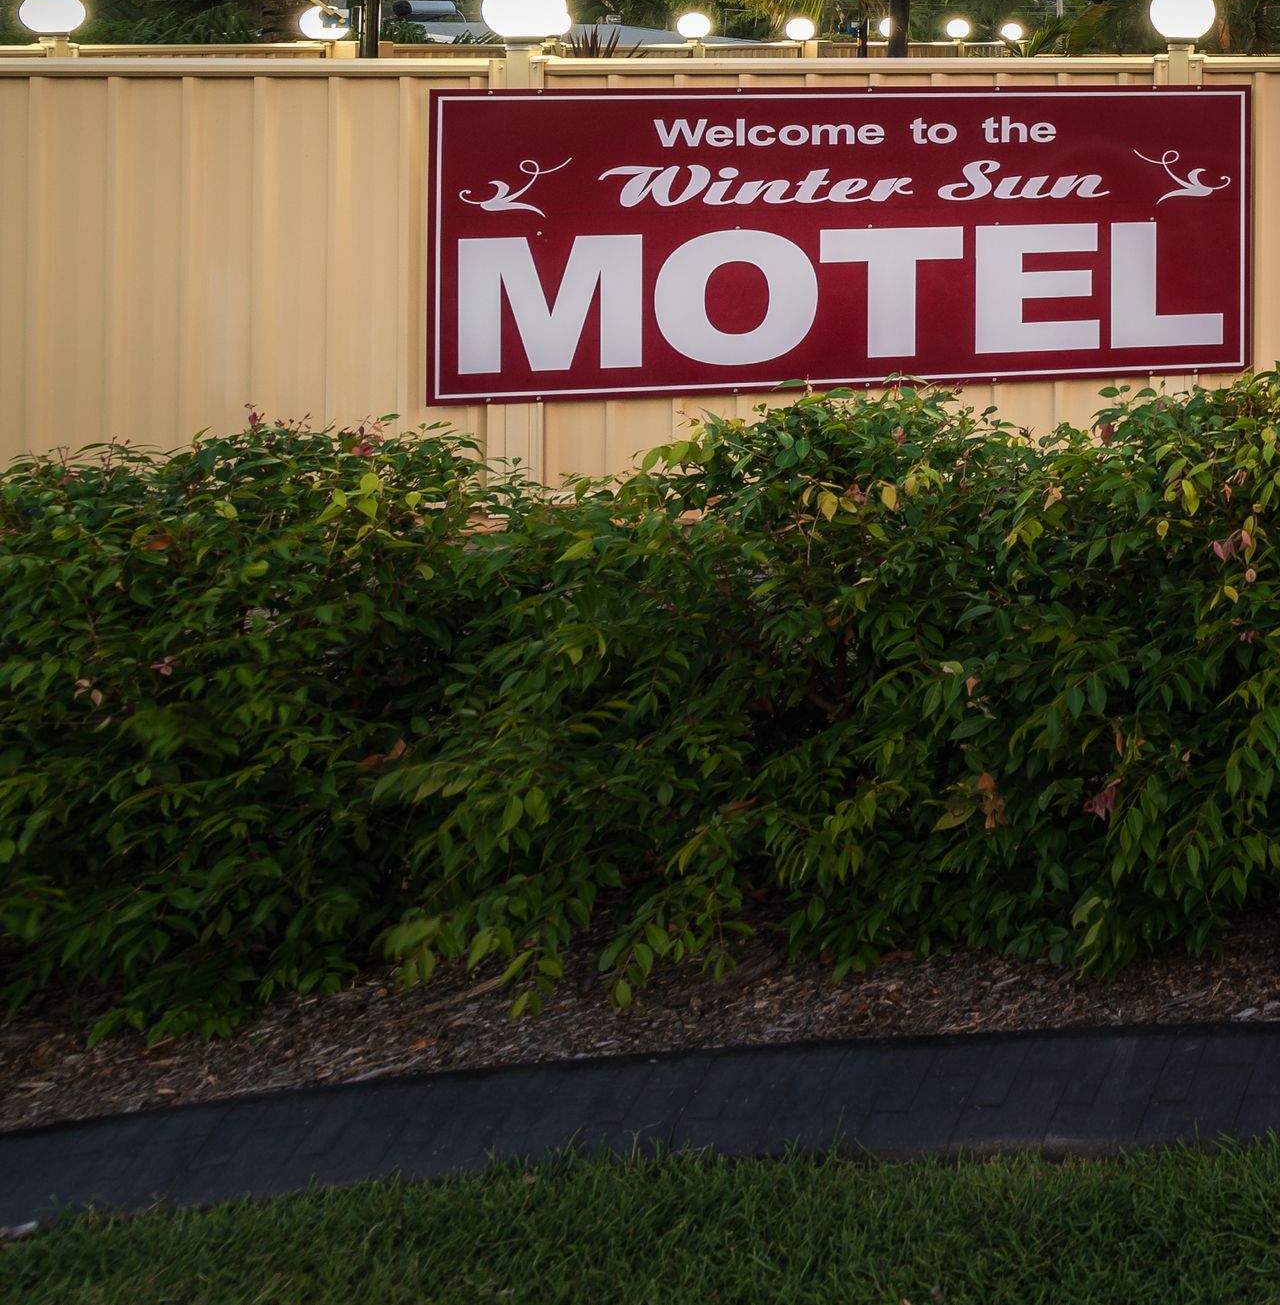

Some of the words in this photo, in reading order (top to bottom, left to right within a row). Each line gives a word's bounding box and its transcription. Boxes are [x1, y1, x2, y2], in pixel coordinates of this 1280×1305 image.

[653, 118, 886, 148] Welcome
[910, 117, 957, 145] to
[982, 115, 1057, 144] the
[598, 163, 914, 208] Winter
[937, 159, 1111, 201] Sun
[457, 221, 1224, 375] MOTEL
